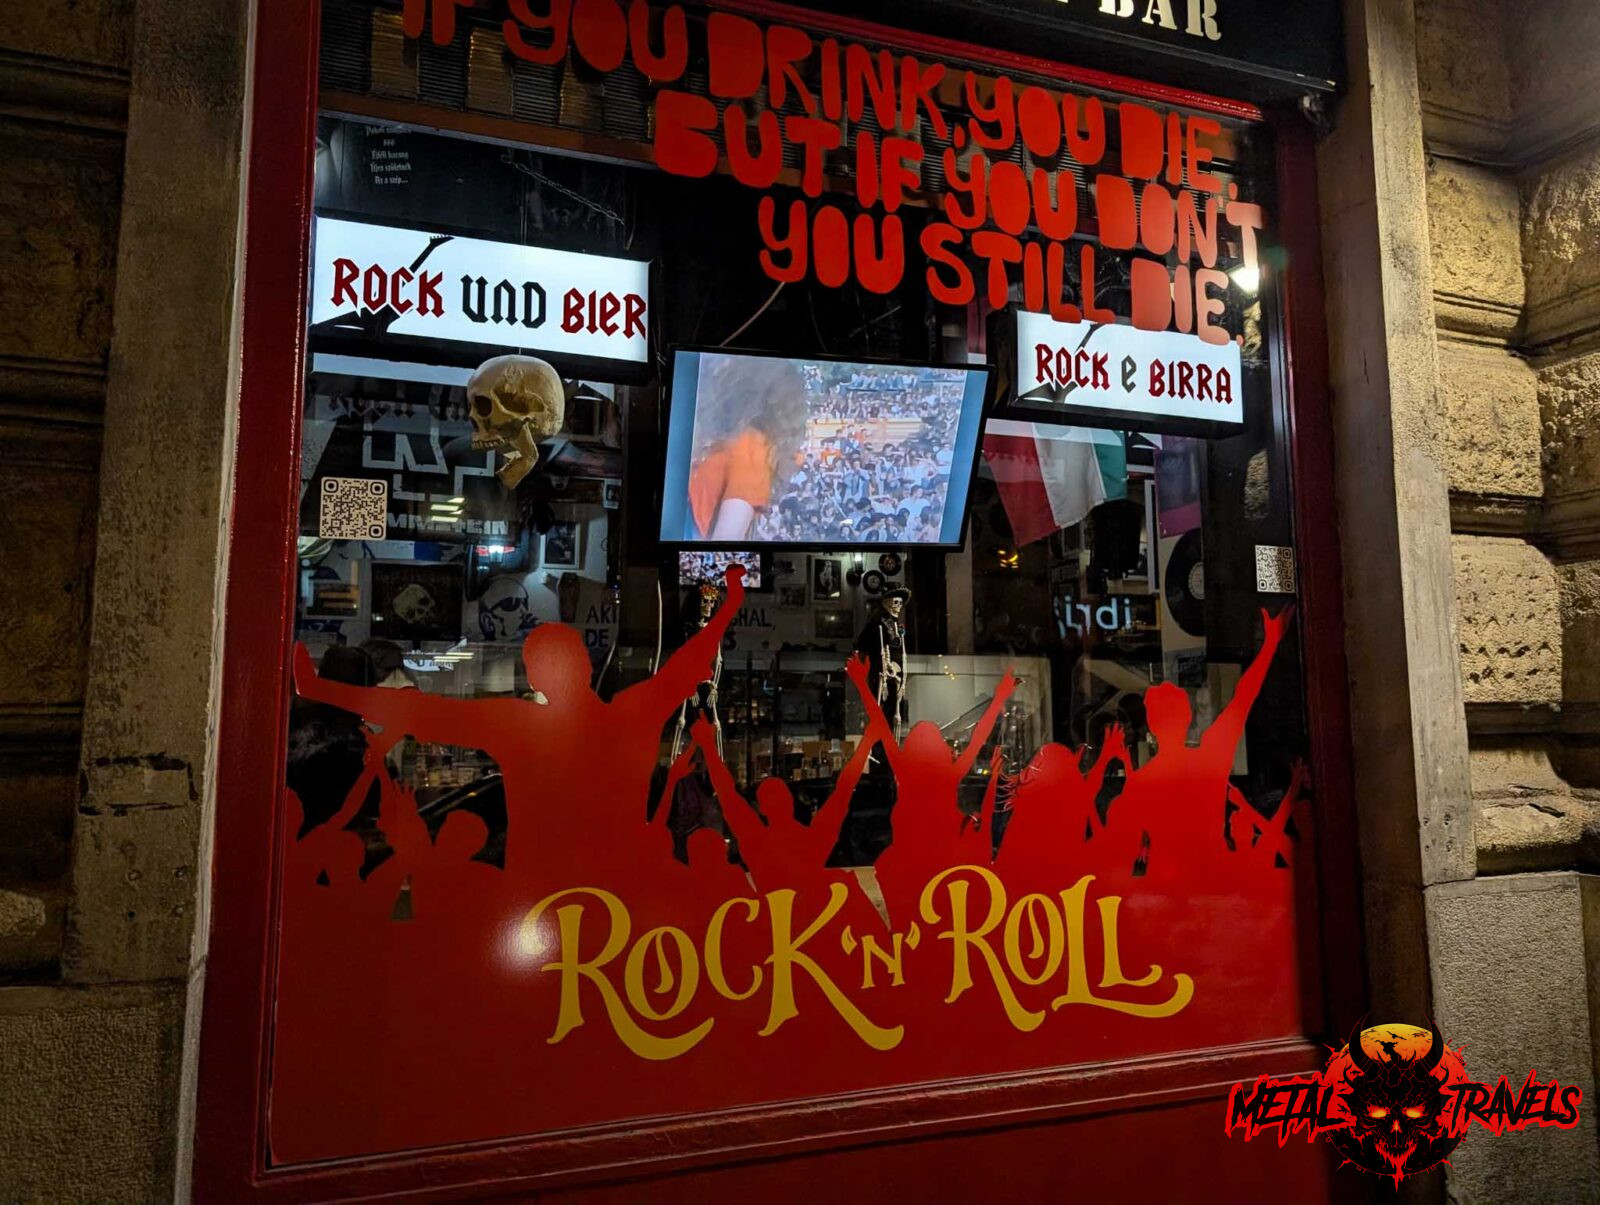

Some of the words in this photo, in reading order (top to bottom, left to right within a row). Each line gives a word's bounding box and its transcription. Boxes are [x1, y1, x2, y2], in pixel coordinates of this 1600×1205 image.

[654, 90, 840, 198] BUT
[857, 131, 923, 212] IF
[943, 147, 1077, 240] YOU
[1095, 174, 1263, 270] DON'T
[965, 71, 1106, 166] YOU
[1119, 102, 1238, 200] DIE.
[330, 258, 445, 318] ROCK
[759, 196, 904, 294] YOU
[920, 222, 1117, 325] STILL
[1131, 257, 1244, 346] DIE.
[1035, 343, 1110, 391] ROCK
[1148, 358, 1233, 404] BIRRA
[517, 882, 904, 1061] ROCK
[920, 864, 1194, 1032] ROLL
